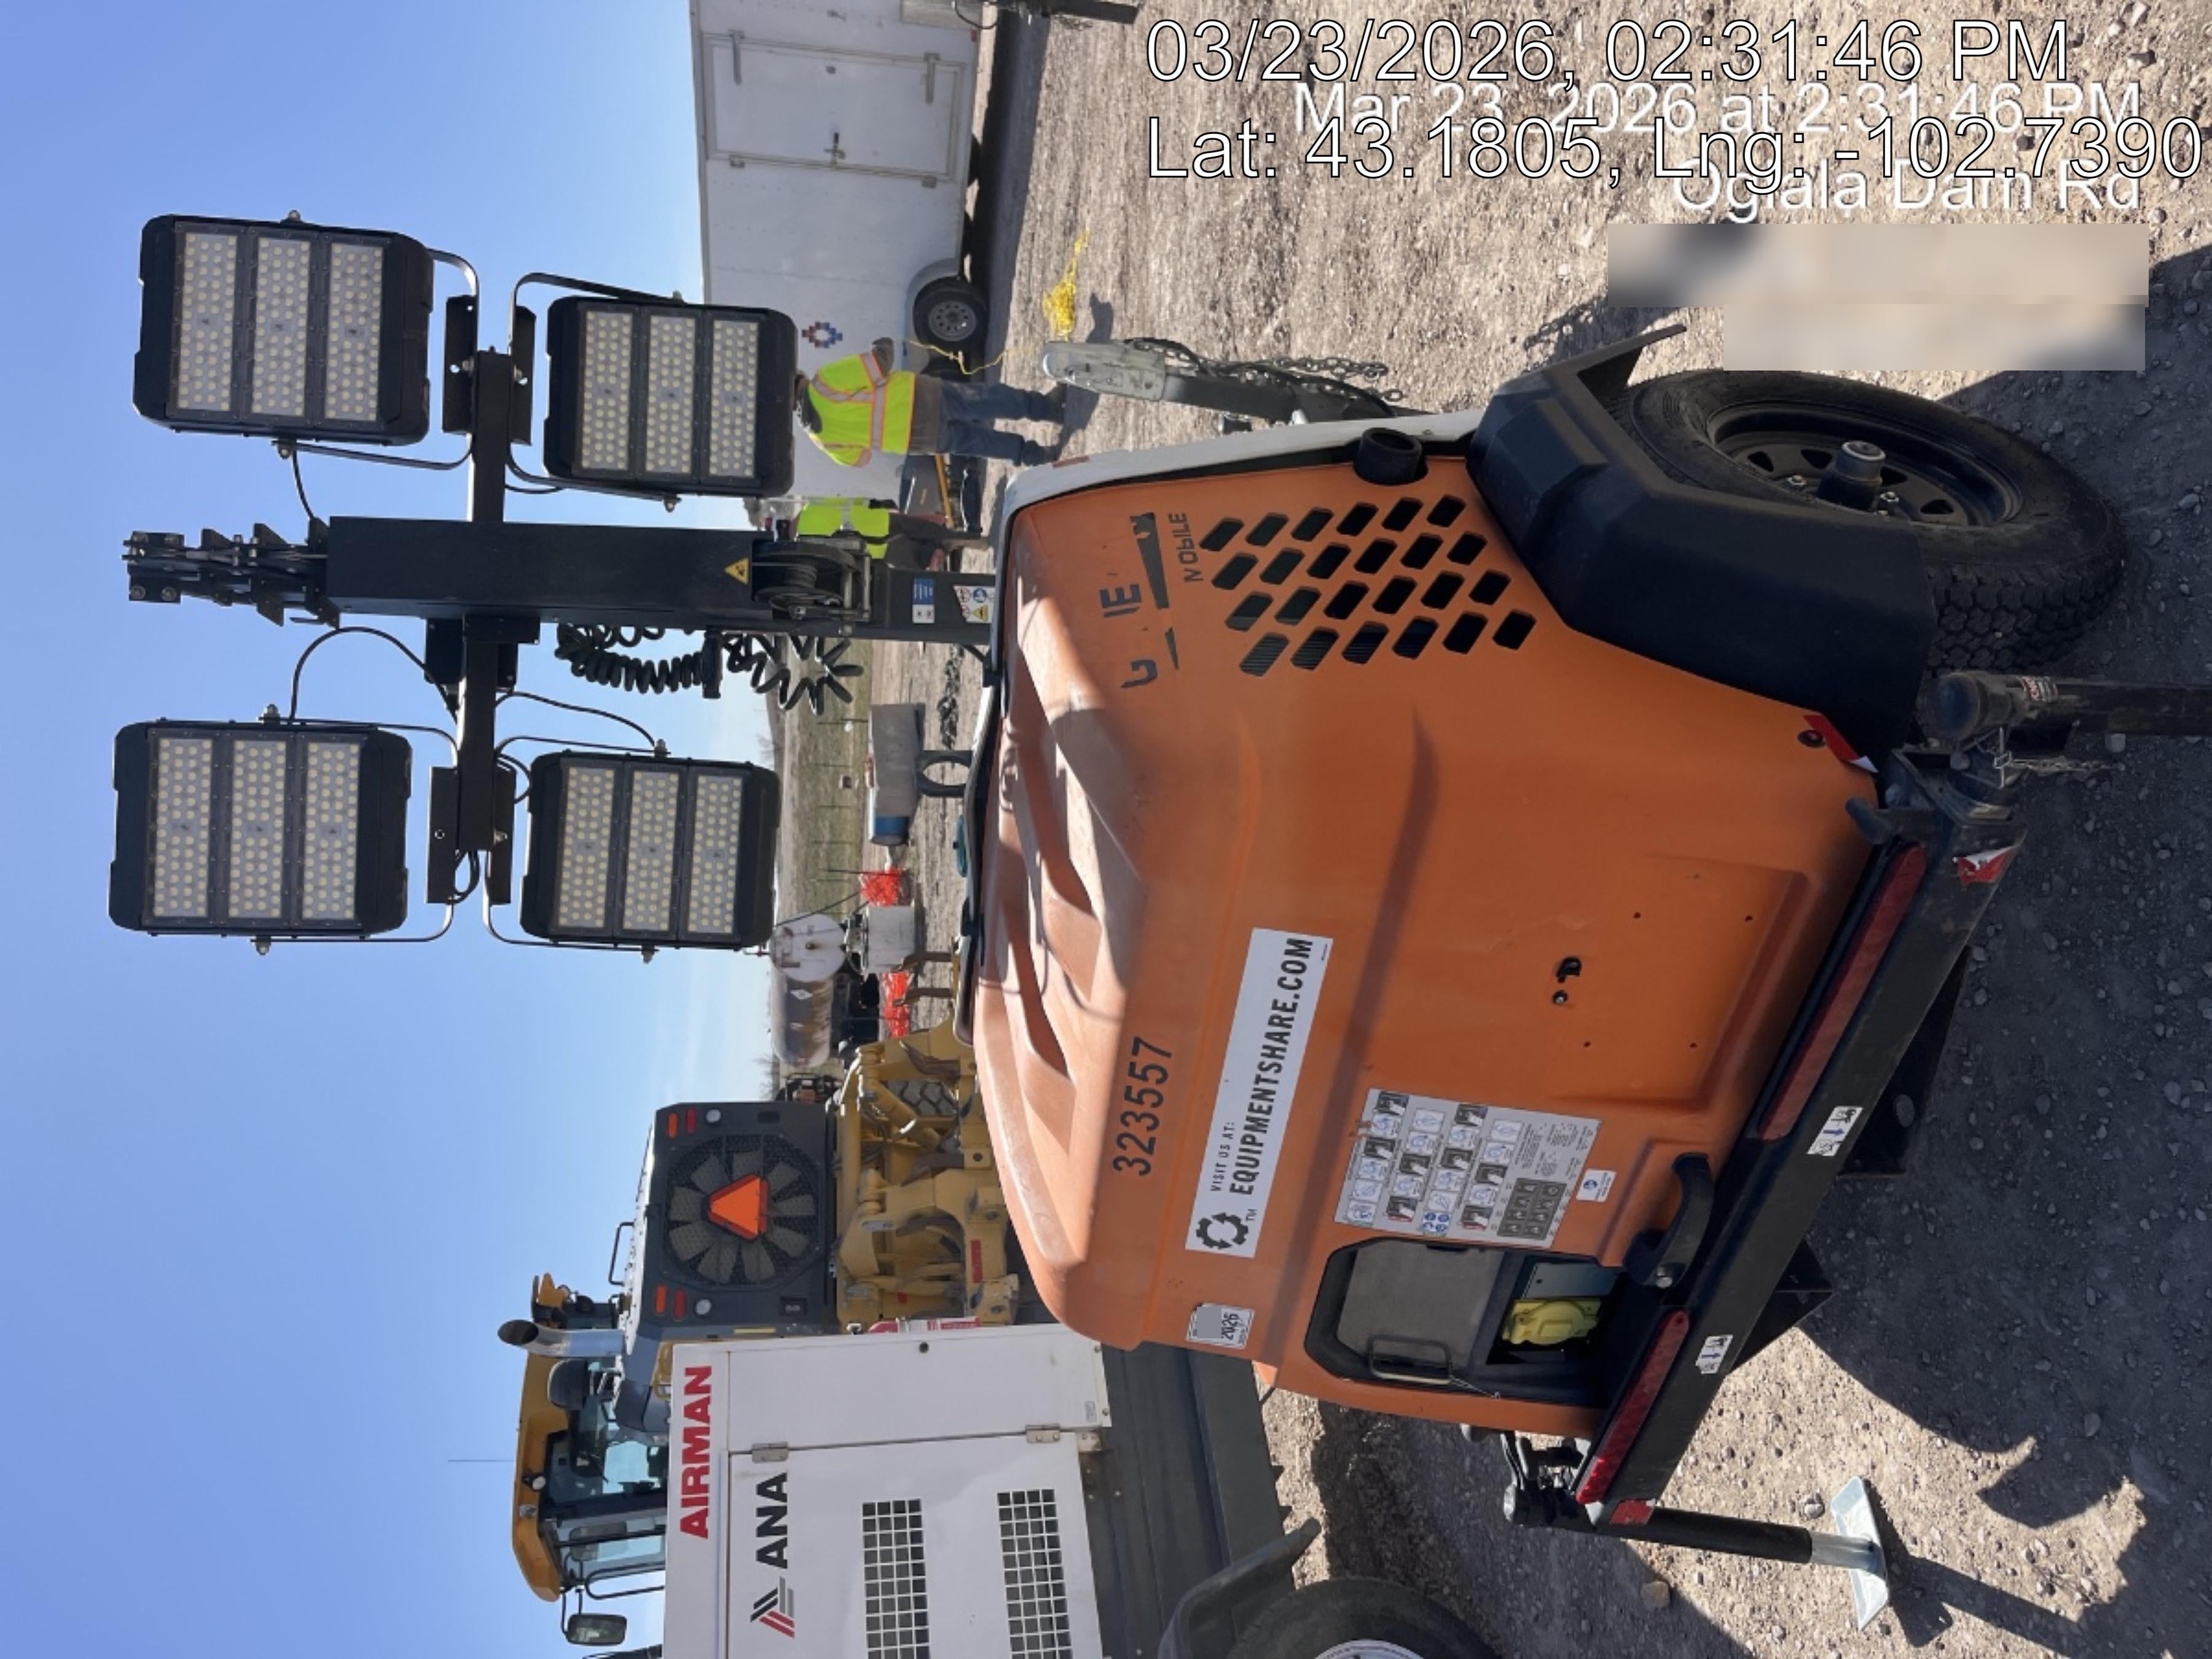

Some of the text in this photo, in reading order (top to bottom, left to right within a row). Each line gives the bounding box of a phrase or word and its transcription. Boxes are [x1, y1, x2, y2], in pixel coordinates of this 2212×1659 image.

[1113, 1036, 1172, 1177] 323557
[1229, 938, 1313, 1195] EQUIPMENTSHARE.COM
[1210, 1122, 1235, 1191] VISIT US AT:
[1221, 1312, 1239, 1341] 2026
[680, 1365, 712, 1539] AIRMAN
[755, 1472, 788, 1569] ANA
